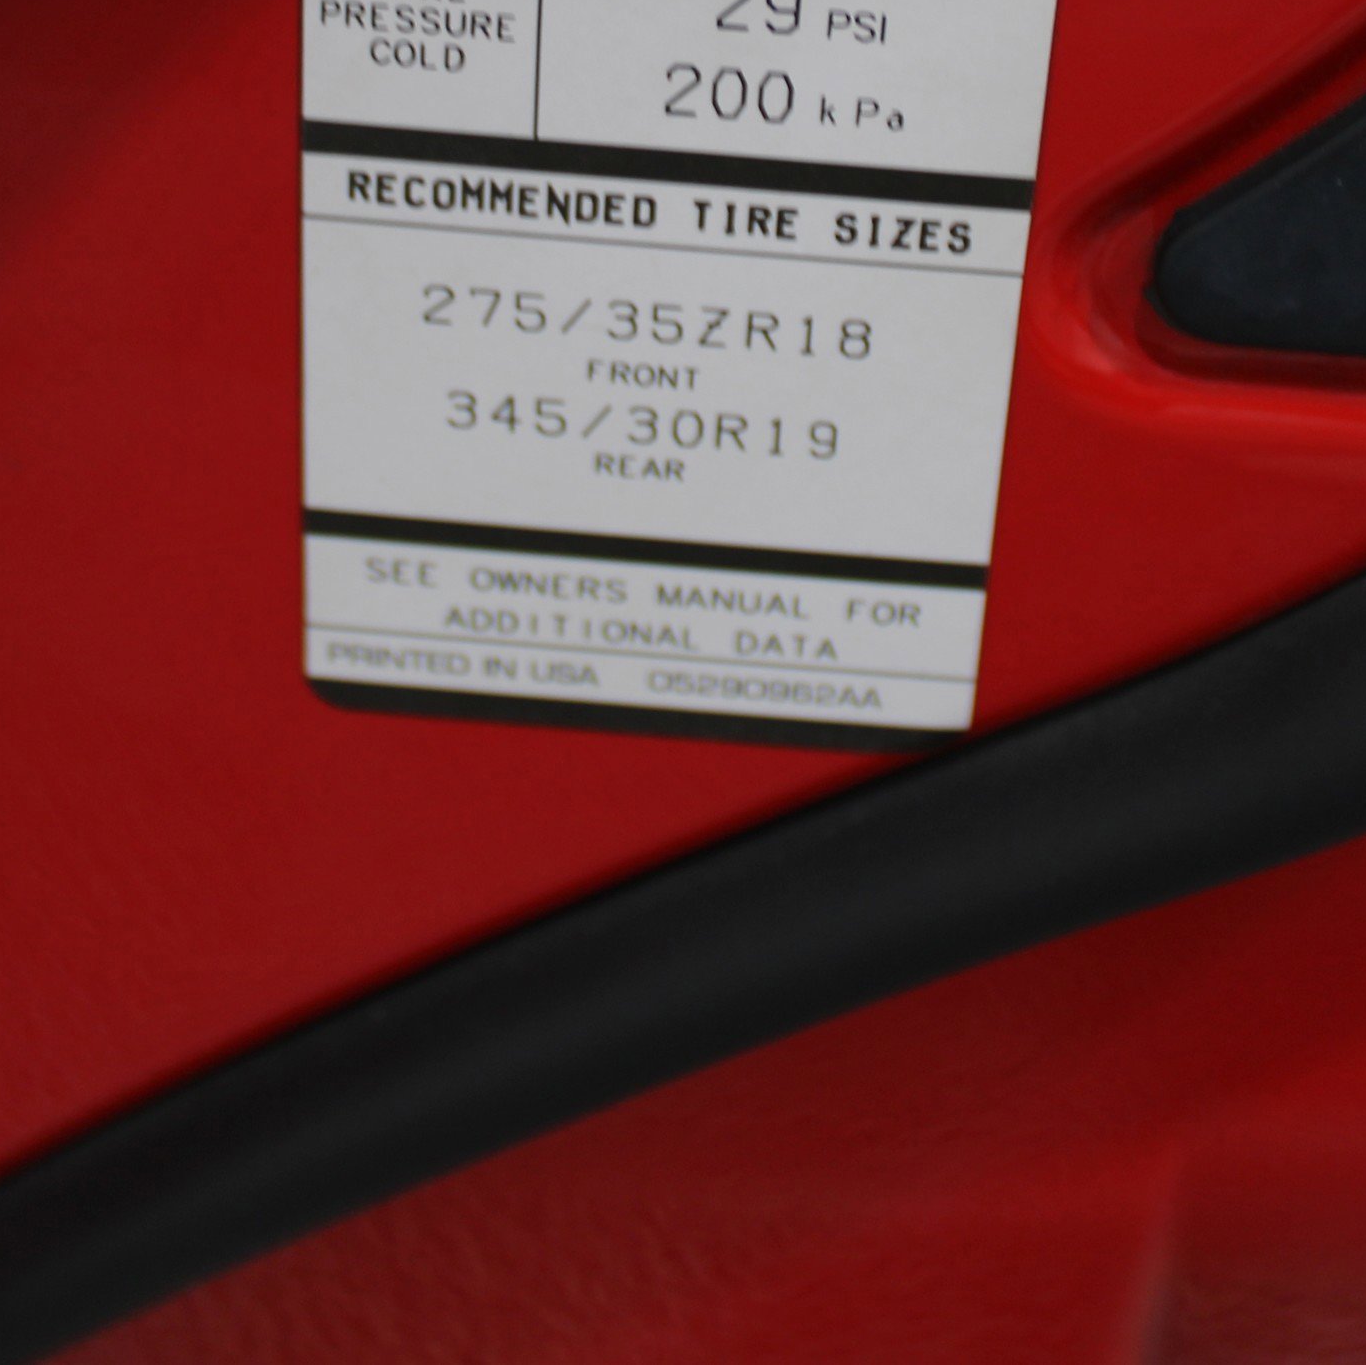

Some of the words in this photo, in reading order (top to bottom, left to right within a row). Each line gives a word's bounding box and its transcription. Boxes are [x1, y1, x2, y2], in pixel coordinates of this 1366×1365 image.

[319, 1, 516, 44] PRESSURE
[827, 8, 887, 45] PSI
[369, 39, 466, 73] COLD
[664, 64, 795, 126] 200
[347, 169, 658, 228] RECOMMENDED
[693, 200, 798, 240] TIRE
[834, 214, 972, 254] SIZES
[421, 283, 874, 361] 275/35ZR18
[586, 358, 701, 391] FRONT
[445, 389, 841, 461] 345/30R19
[593, 452, 686, 483] REAR
[364, 556, 438, 589] SEE
[470, 563, 628, 606] OWNERS
[655, 582, 811, 622] MANUAL
[846, 598, 923, 629] FOR
[443, 605, 701, 652] ADDITIONAL
[736, 629, 839, 663] DATA
[326, 641, 471, 677] PRINTED
[482, 654, 517, 679] IN
[530, 660, 600, 686] USA
